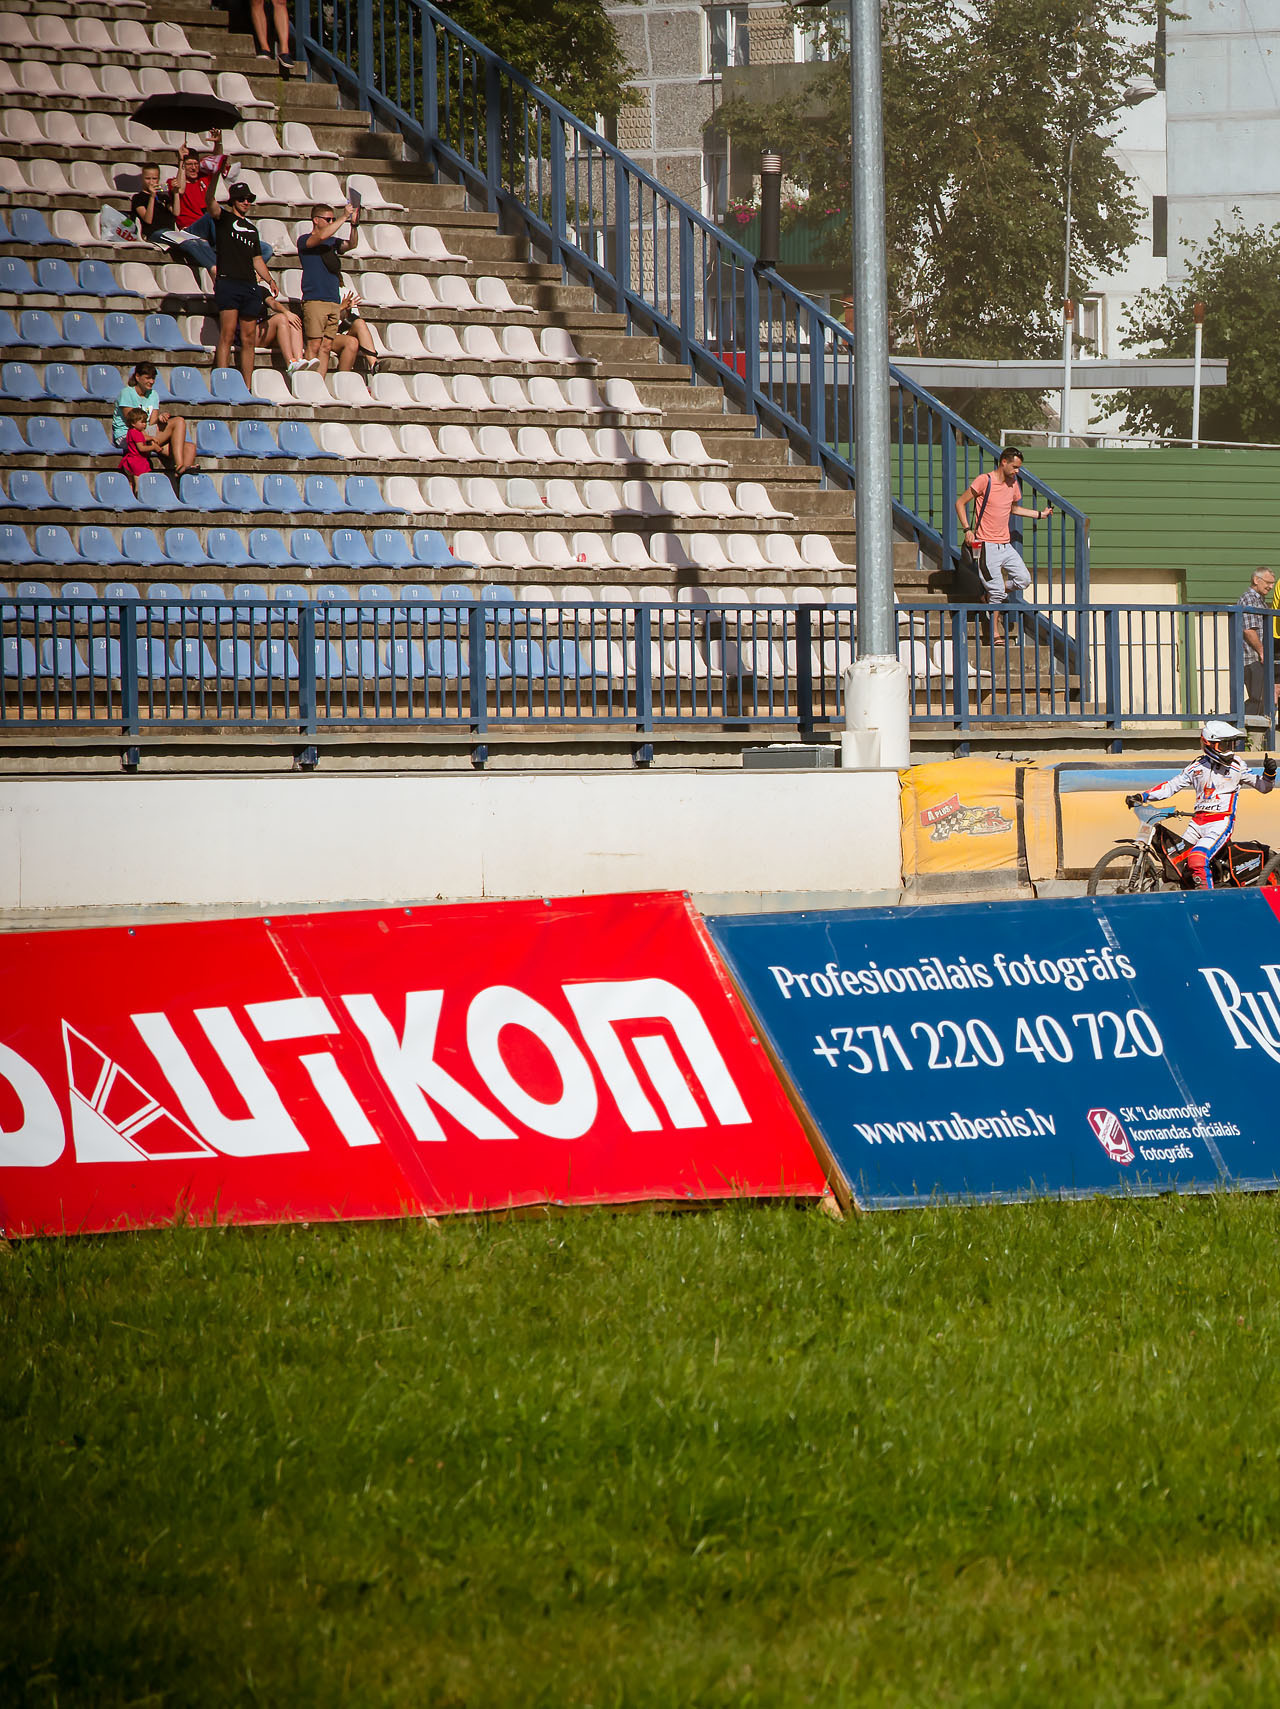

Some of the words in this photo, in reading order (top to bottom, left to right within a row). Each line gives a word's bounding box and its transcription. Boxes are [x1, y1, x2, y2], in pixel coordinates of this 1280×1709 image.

[115, 316, 125, 324] 12
[208, 423, 216, 431] 13
[248, 423, 258, 432] 12
[316, 480, 324, 489] 12
[28, 585, 36, 594] 22
[451, 589, 460, 598] 12
[768, 957, 993, 999] Profesionālais
[993, 947, 1137, 992] fotogrāfs
[813, 1024, 913, 1074] +371
[910, 1018, 1005, 1070] 220
[1015, 1014, 1074, 1063] 40
[1071, 1008, 1164, 1061] 720
[1119, 1107, 1139, 1123] SK
[852, 1107, 1057, 1145] www.rubenis.lv
[1128, 1123, 1192, 1142] komandas
[1192, 1121, 1241, 1138] oficiālais
[1139, 1143, 1194, 1164] fotogrāfs
